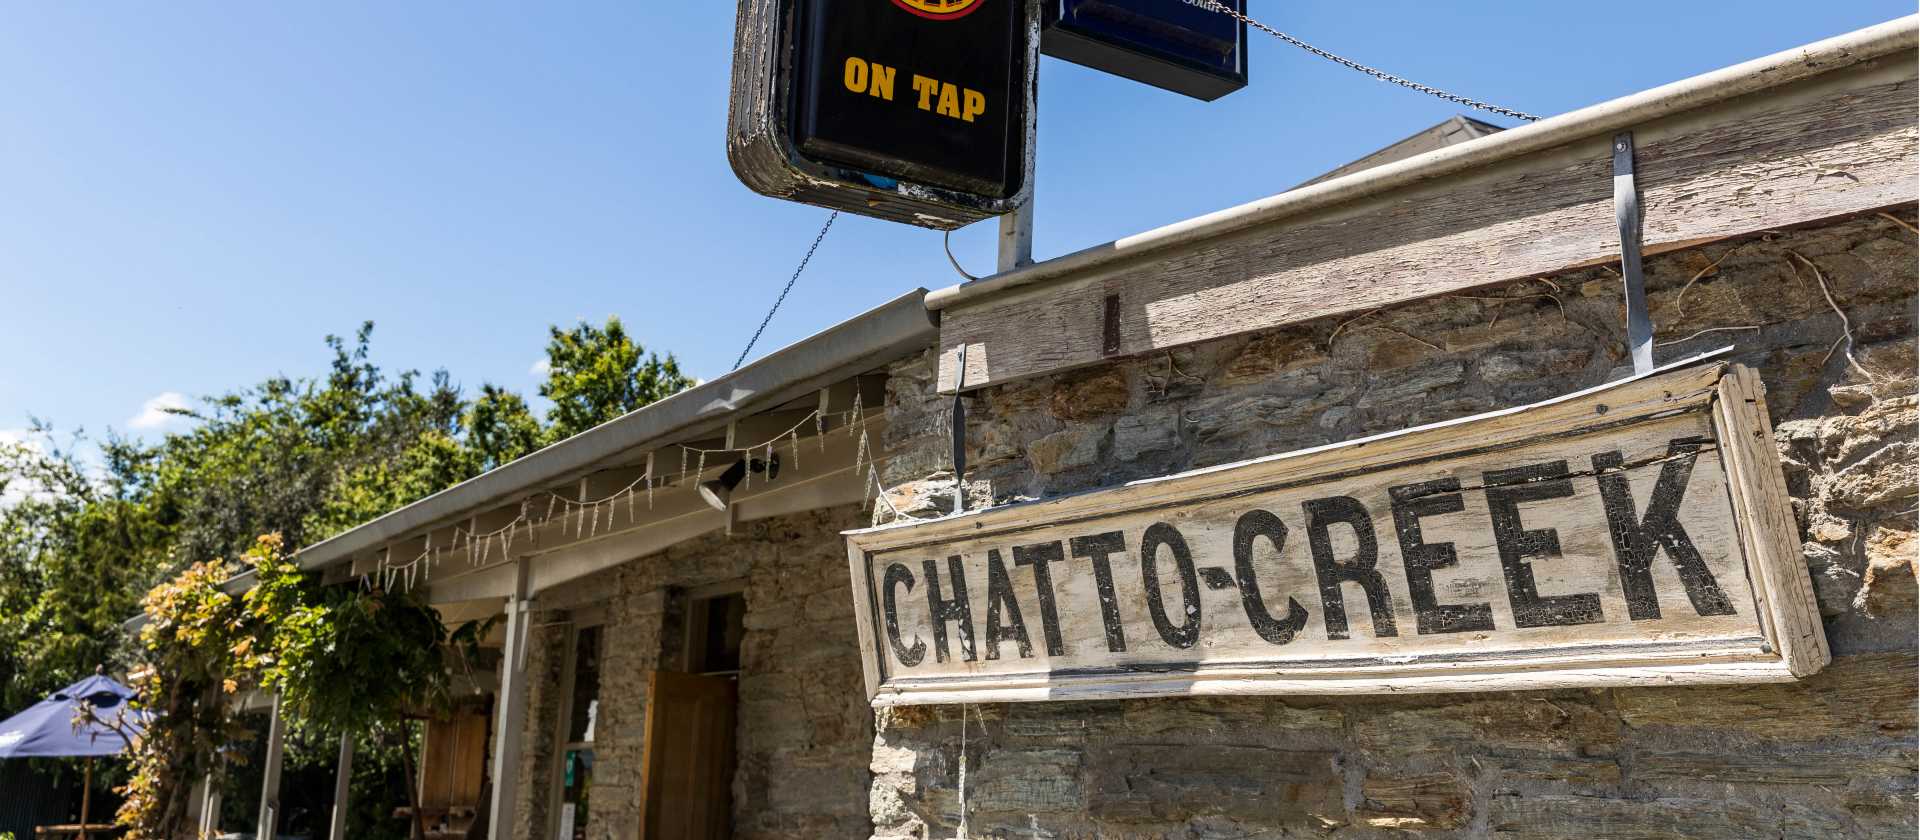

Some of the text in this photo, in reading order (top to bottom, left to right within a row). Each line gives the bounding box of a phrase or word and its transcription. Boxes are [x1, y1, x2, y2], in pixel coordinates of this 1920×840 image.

[845, 57, 986, 122] ON TAP
[882, 437, 1736, 667] CHATTO-CREEK
